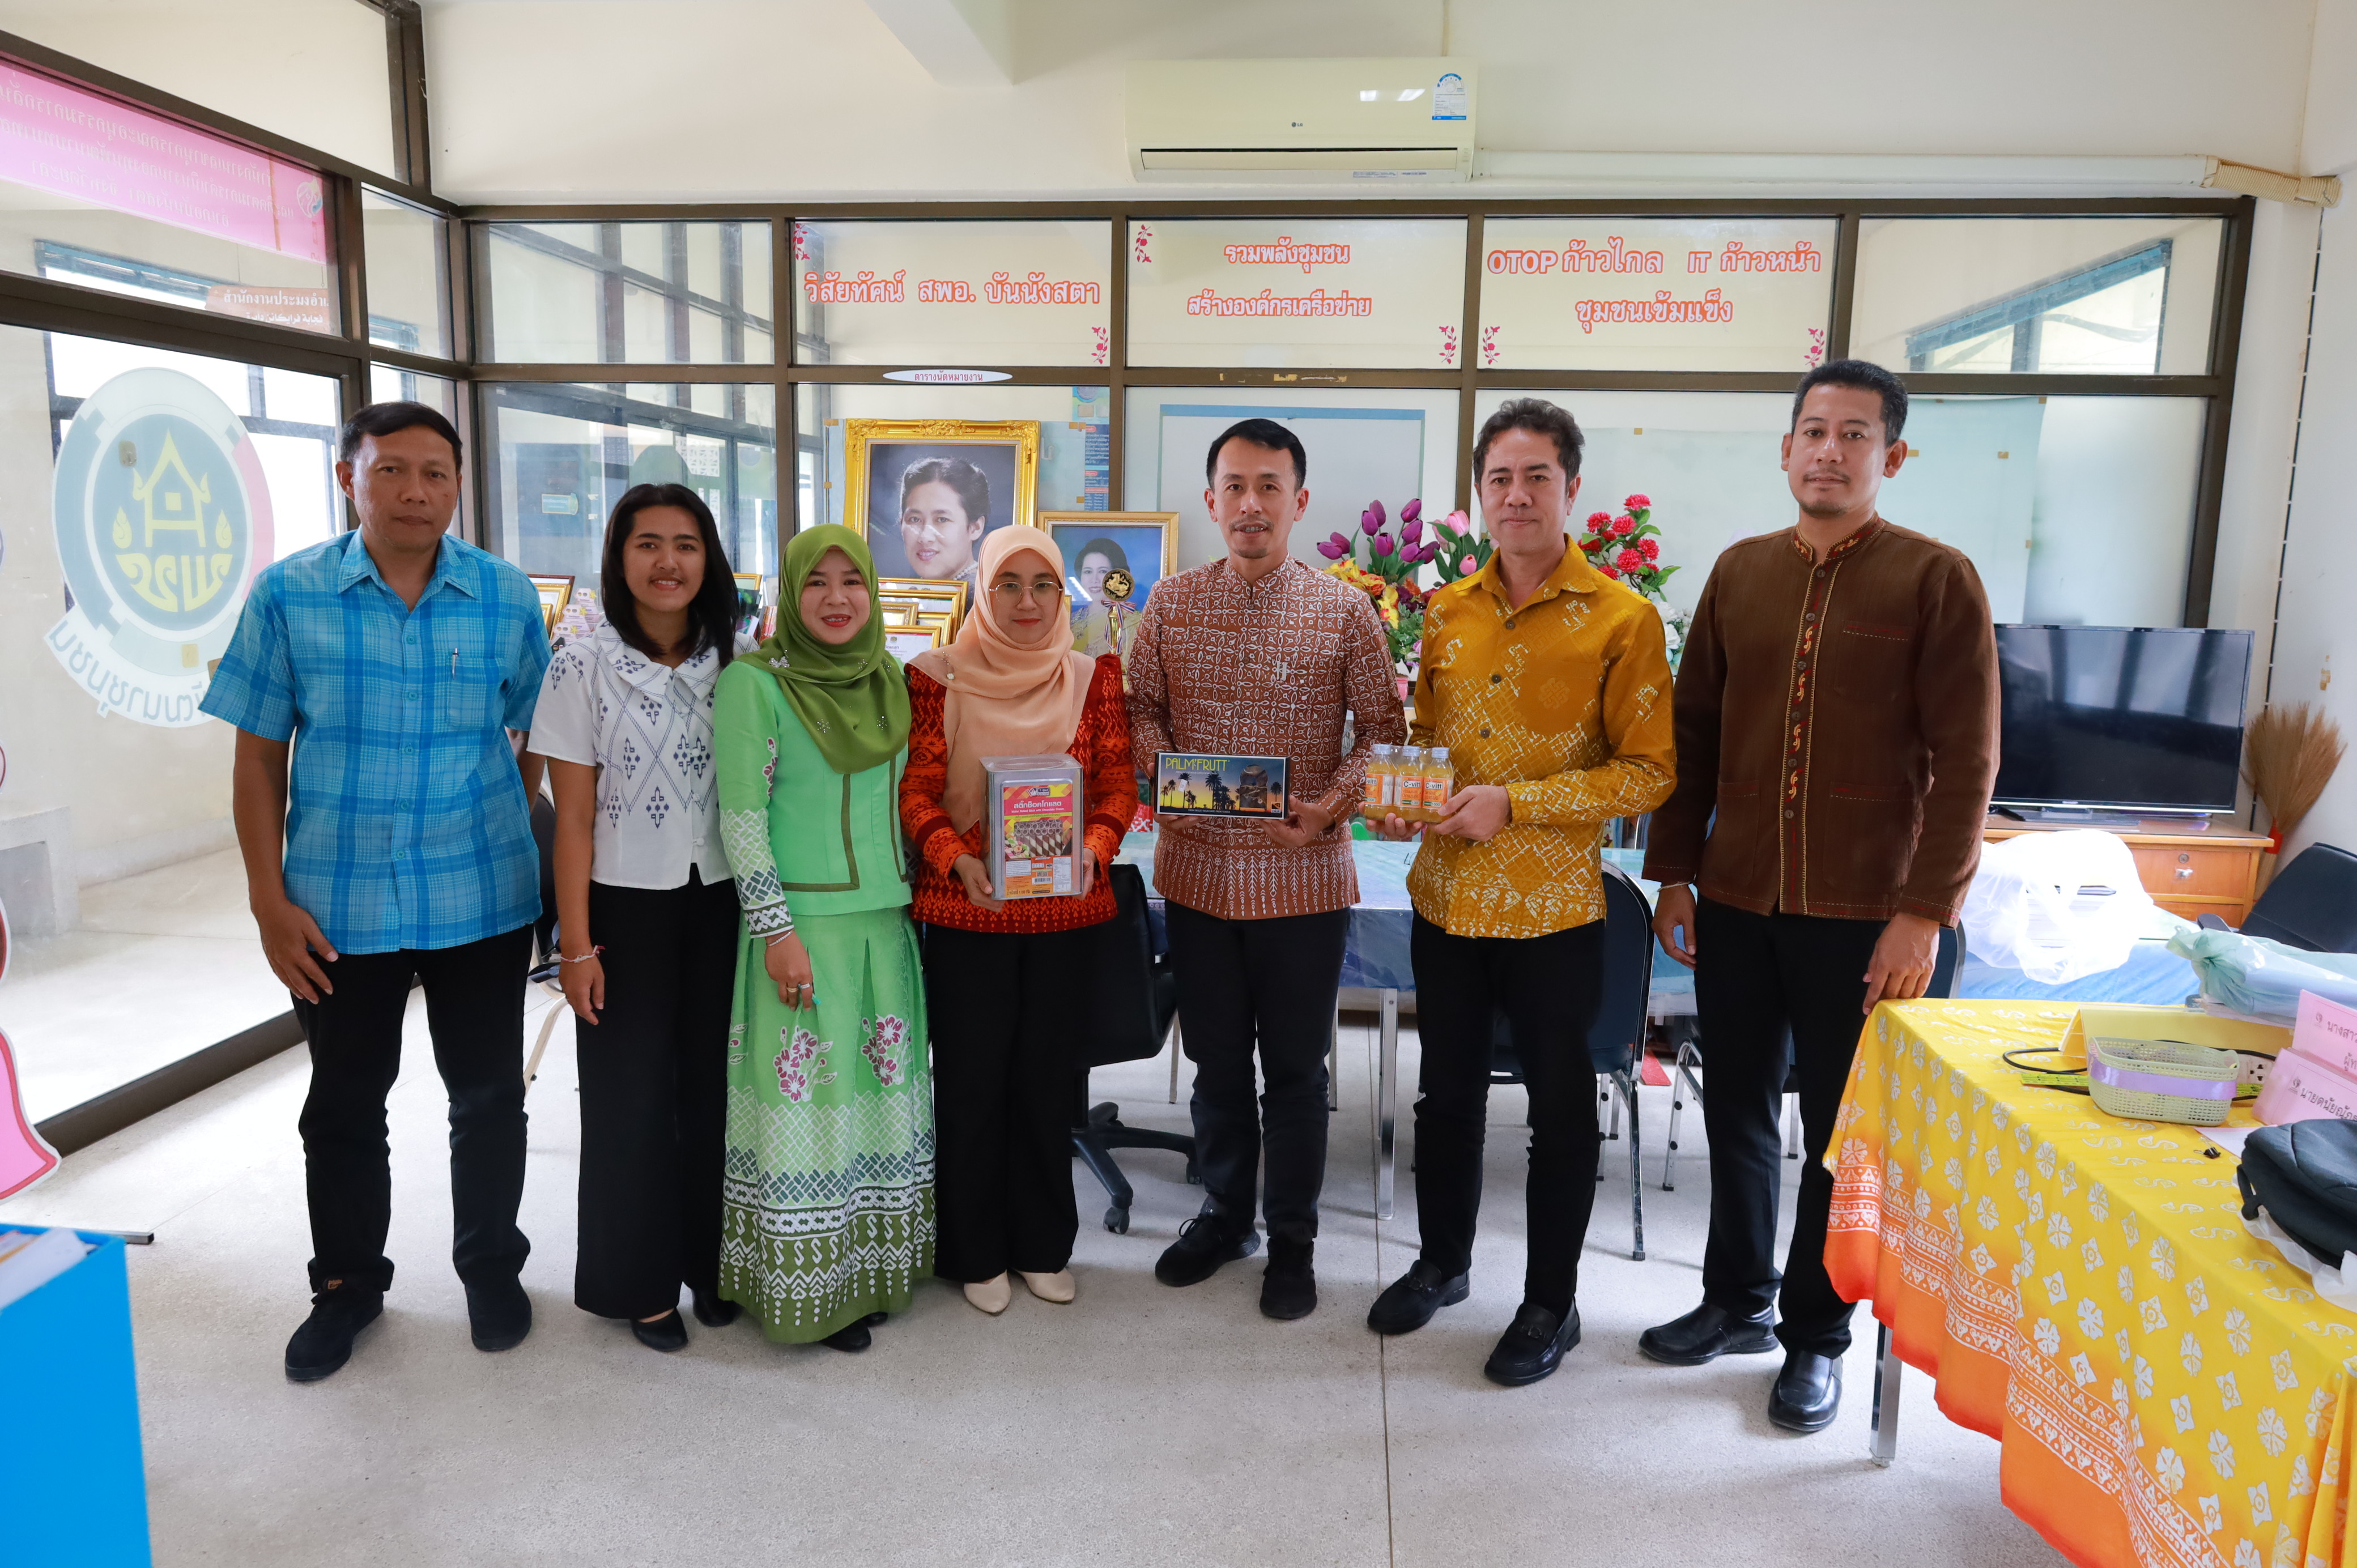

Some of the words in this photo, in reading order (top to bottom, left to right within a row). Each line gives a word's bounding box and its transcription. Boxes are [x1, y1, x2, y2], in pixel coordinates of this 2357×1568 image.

[1224, 236, 1350, 274] รวมพลังชุมชน
[1487, 250, 1558, 274] OTOP
[1562, 236, 1663, 273] ก้าวไกล
[1687, 251, 1712, 272] IT
[1720, 241, 1821, 272] ก้าวหน้า
[223, 288, 329, 308] สำนักงานประมงอำเ
[805, 269, 906, 304] วิสัยทัศน์
[918, 280, 976, 302] สพอ.
[984, 271, 1100, 304] บันนังสตา
[1187, 288, 1372, 317] สร้างองค์กรเครือข่าย
[1575, 288, 1733, 334] ชุมชนเข้มแข็ง
[914, 370, 983, 381] ตารางนัดหมายงาน
